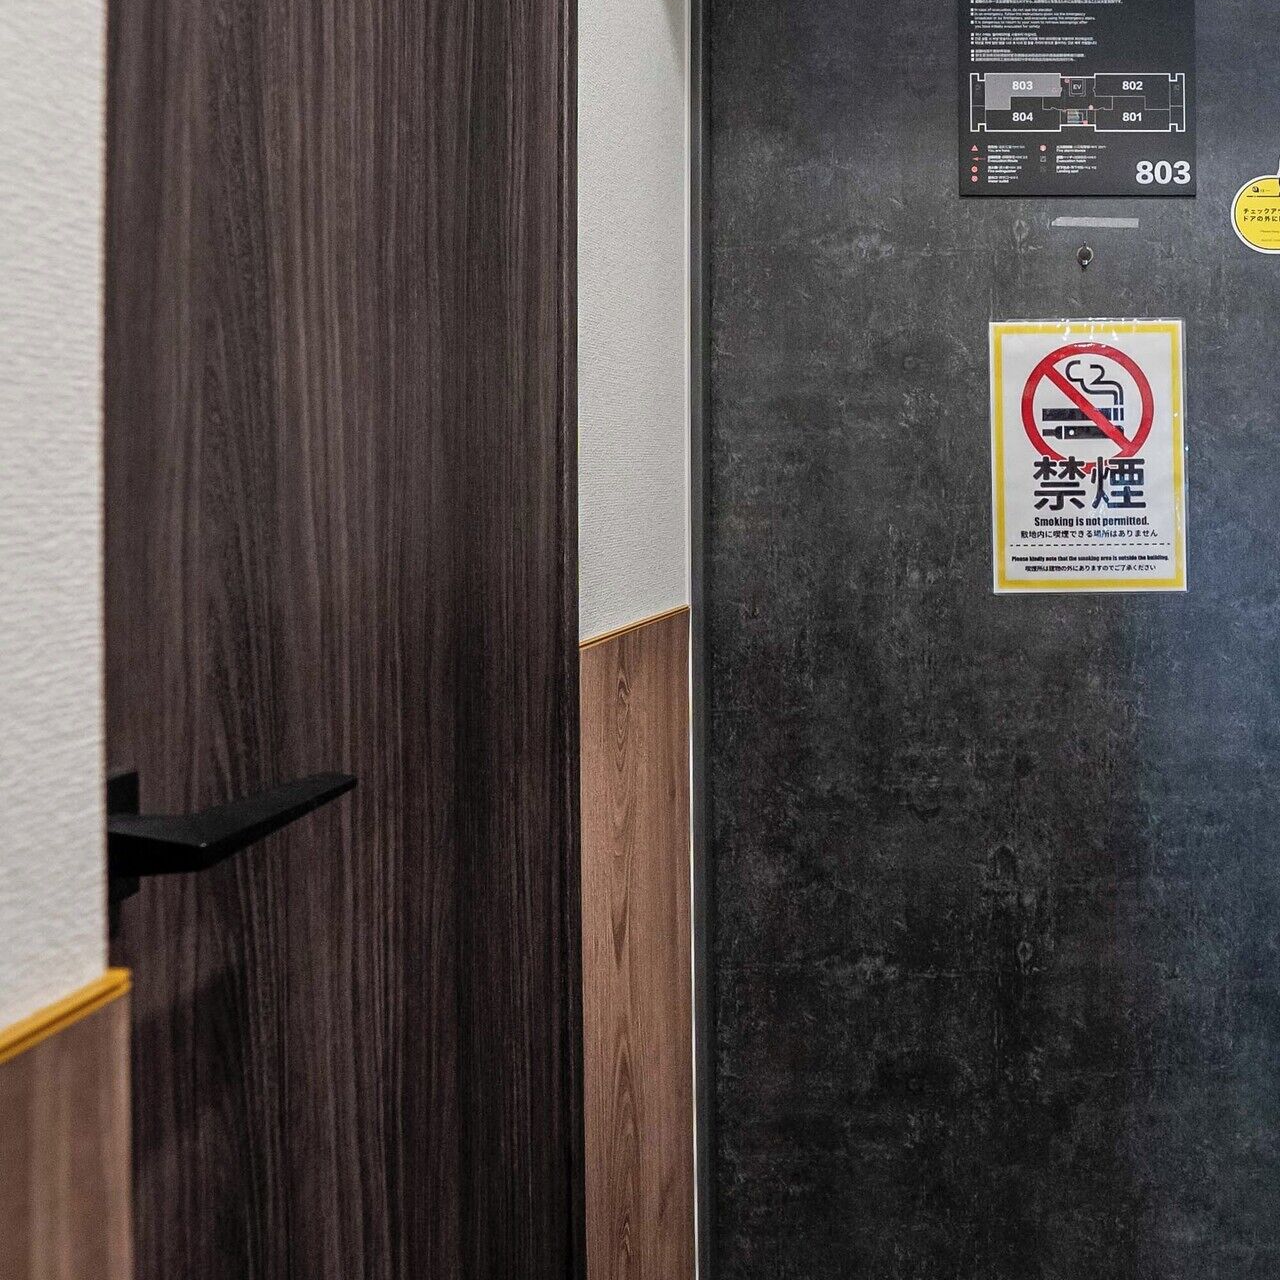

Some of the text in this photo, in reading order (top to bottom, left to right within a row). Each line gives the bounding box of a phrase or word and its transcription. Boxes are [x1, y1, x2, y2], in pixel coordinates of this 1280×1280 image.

[1012, 81, 1033, 91] 803
[1122, 81, 1143, 91] 802
[1012, 112, 1034, 122] 804
[1122, 112, 1143, 122] 801
[1135, 160, 1191, 185] 803
[1032, 456, 1147, 511] 禁煙
[1034, 516, 1150, 528] Smoking is not permitted.
